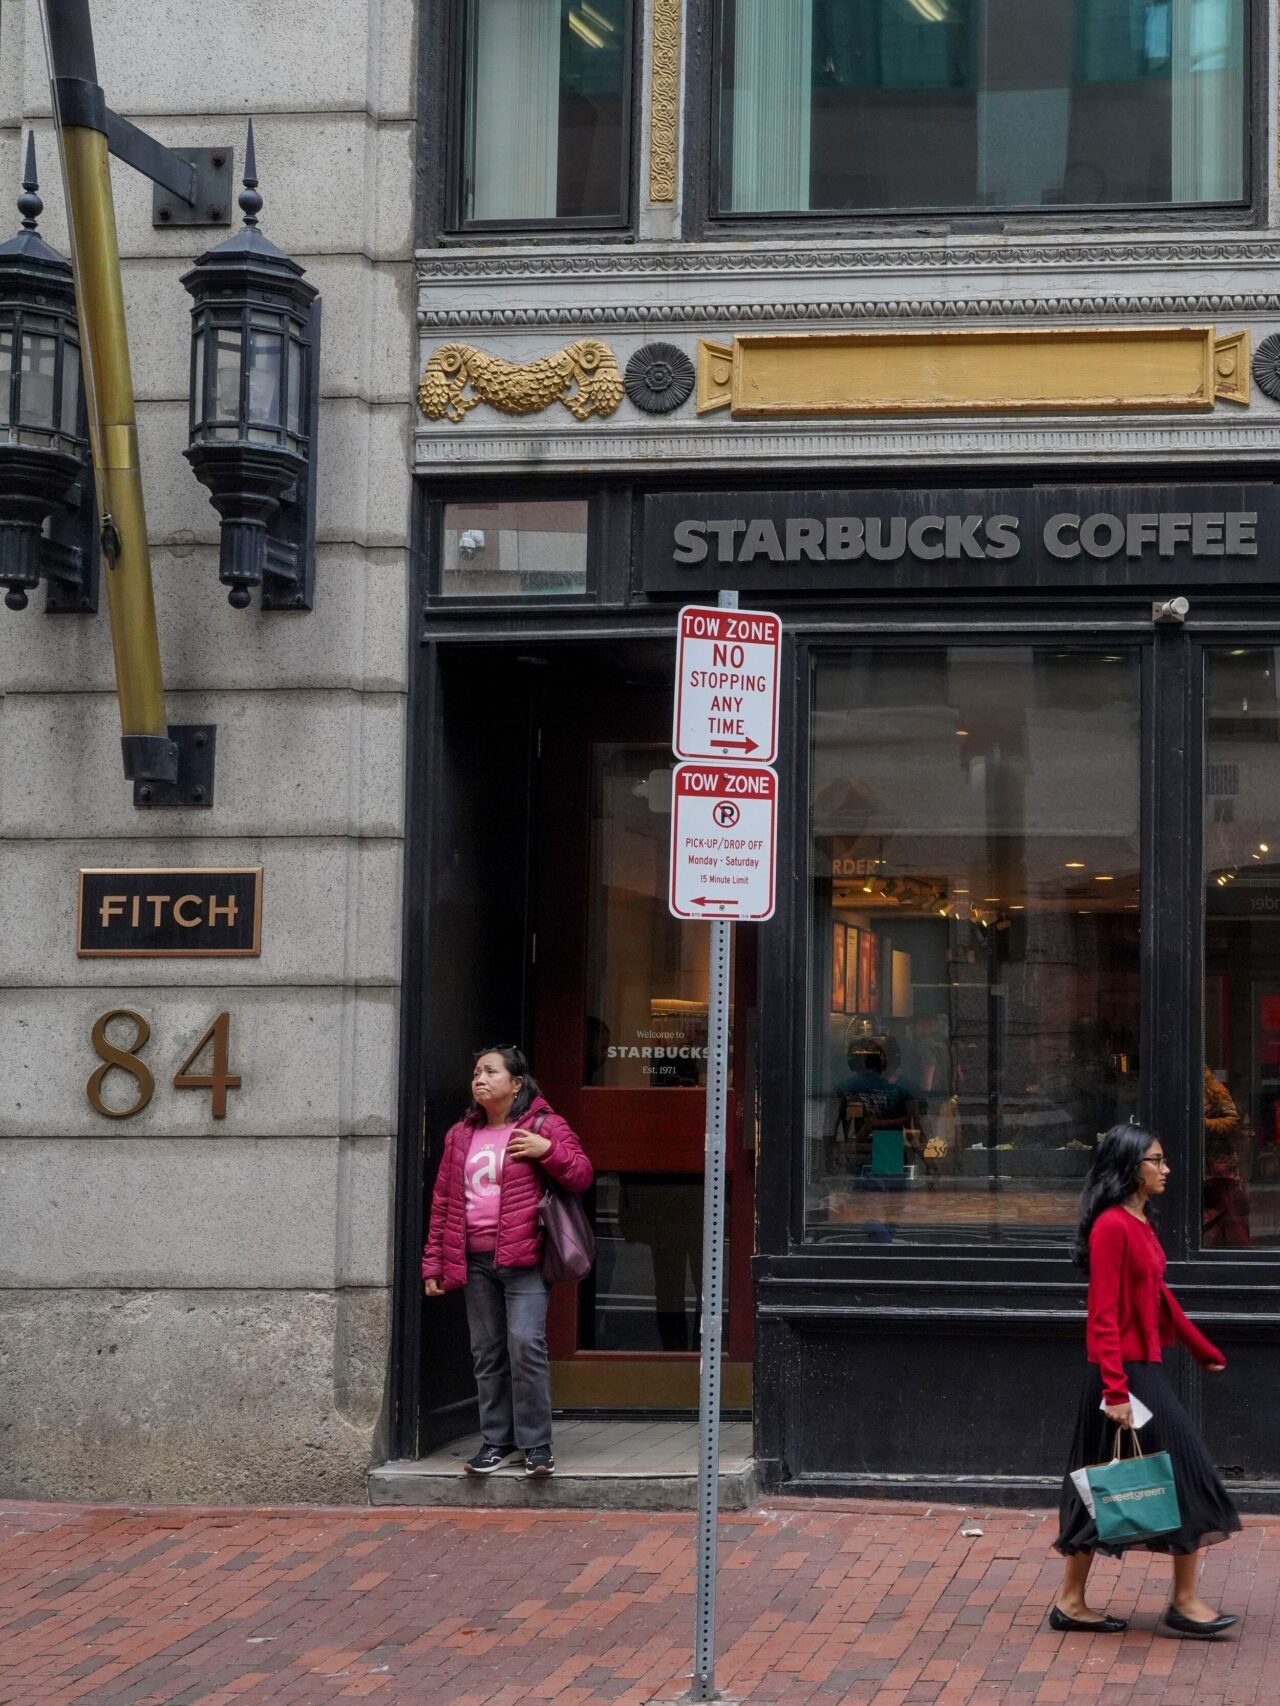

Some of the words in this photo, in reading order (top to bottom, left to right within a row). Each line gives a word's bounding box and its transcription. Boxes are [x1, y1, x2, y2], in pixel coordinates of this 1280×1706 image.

[673, 515, 1021, 563] STARBUCKS
[1043, 512, 1258, 558] COFFEE
[683, 615, 720, 637] TOW
[725, 618, 775, 642] ZONE
[713, 643, 745, 669] NO
[690, 670, 766, 693] STOPPING
[710, 695, 743, 713] ANY
[707, 717, 745, 736] TIME
[681, 772, 719, 792] TOW
[724, 774, 770, 794] ZONE
[685, 837, 746, 851] PICK-UP/DROP
[748, 840, 764, 850] OFF
[688, 855, 718, 868] Monday
[725, 856, 759, 869] Saturday
[700, 874, 708, 884] 15
[709, 875, 731, 884] Minute
[732, 876, 749, 885] Limit
[99, 894, 239, 928] FITCH
[636, 1029, 674, 1039] Welcome
[675, 1030, 685, 1039] to
[86, 1008, 242, 1119] 84
[642, 1066, 657, 1075] Est.
[659, 1066, 676, 1075] 1971
[1102, 1487, 1165, 1504] sweetgreen
